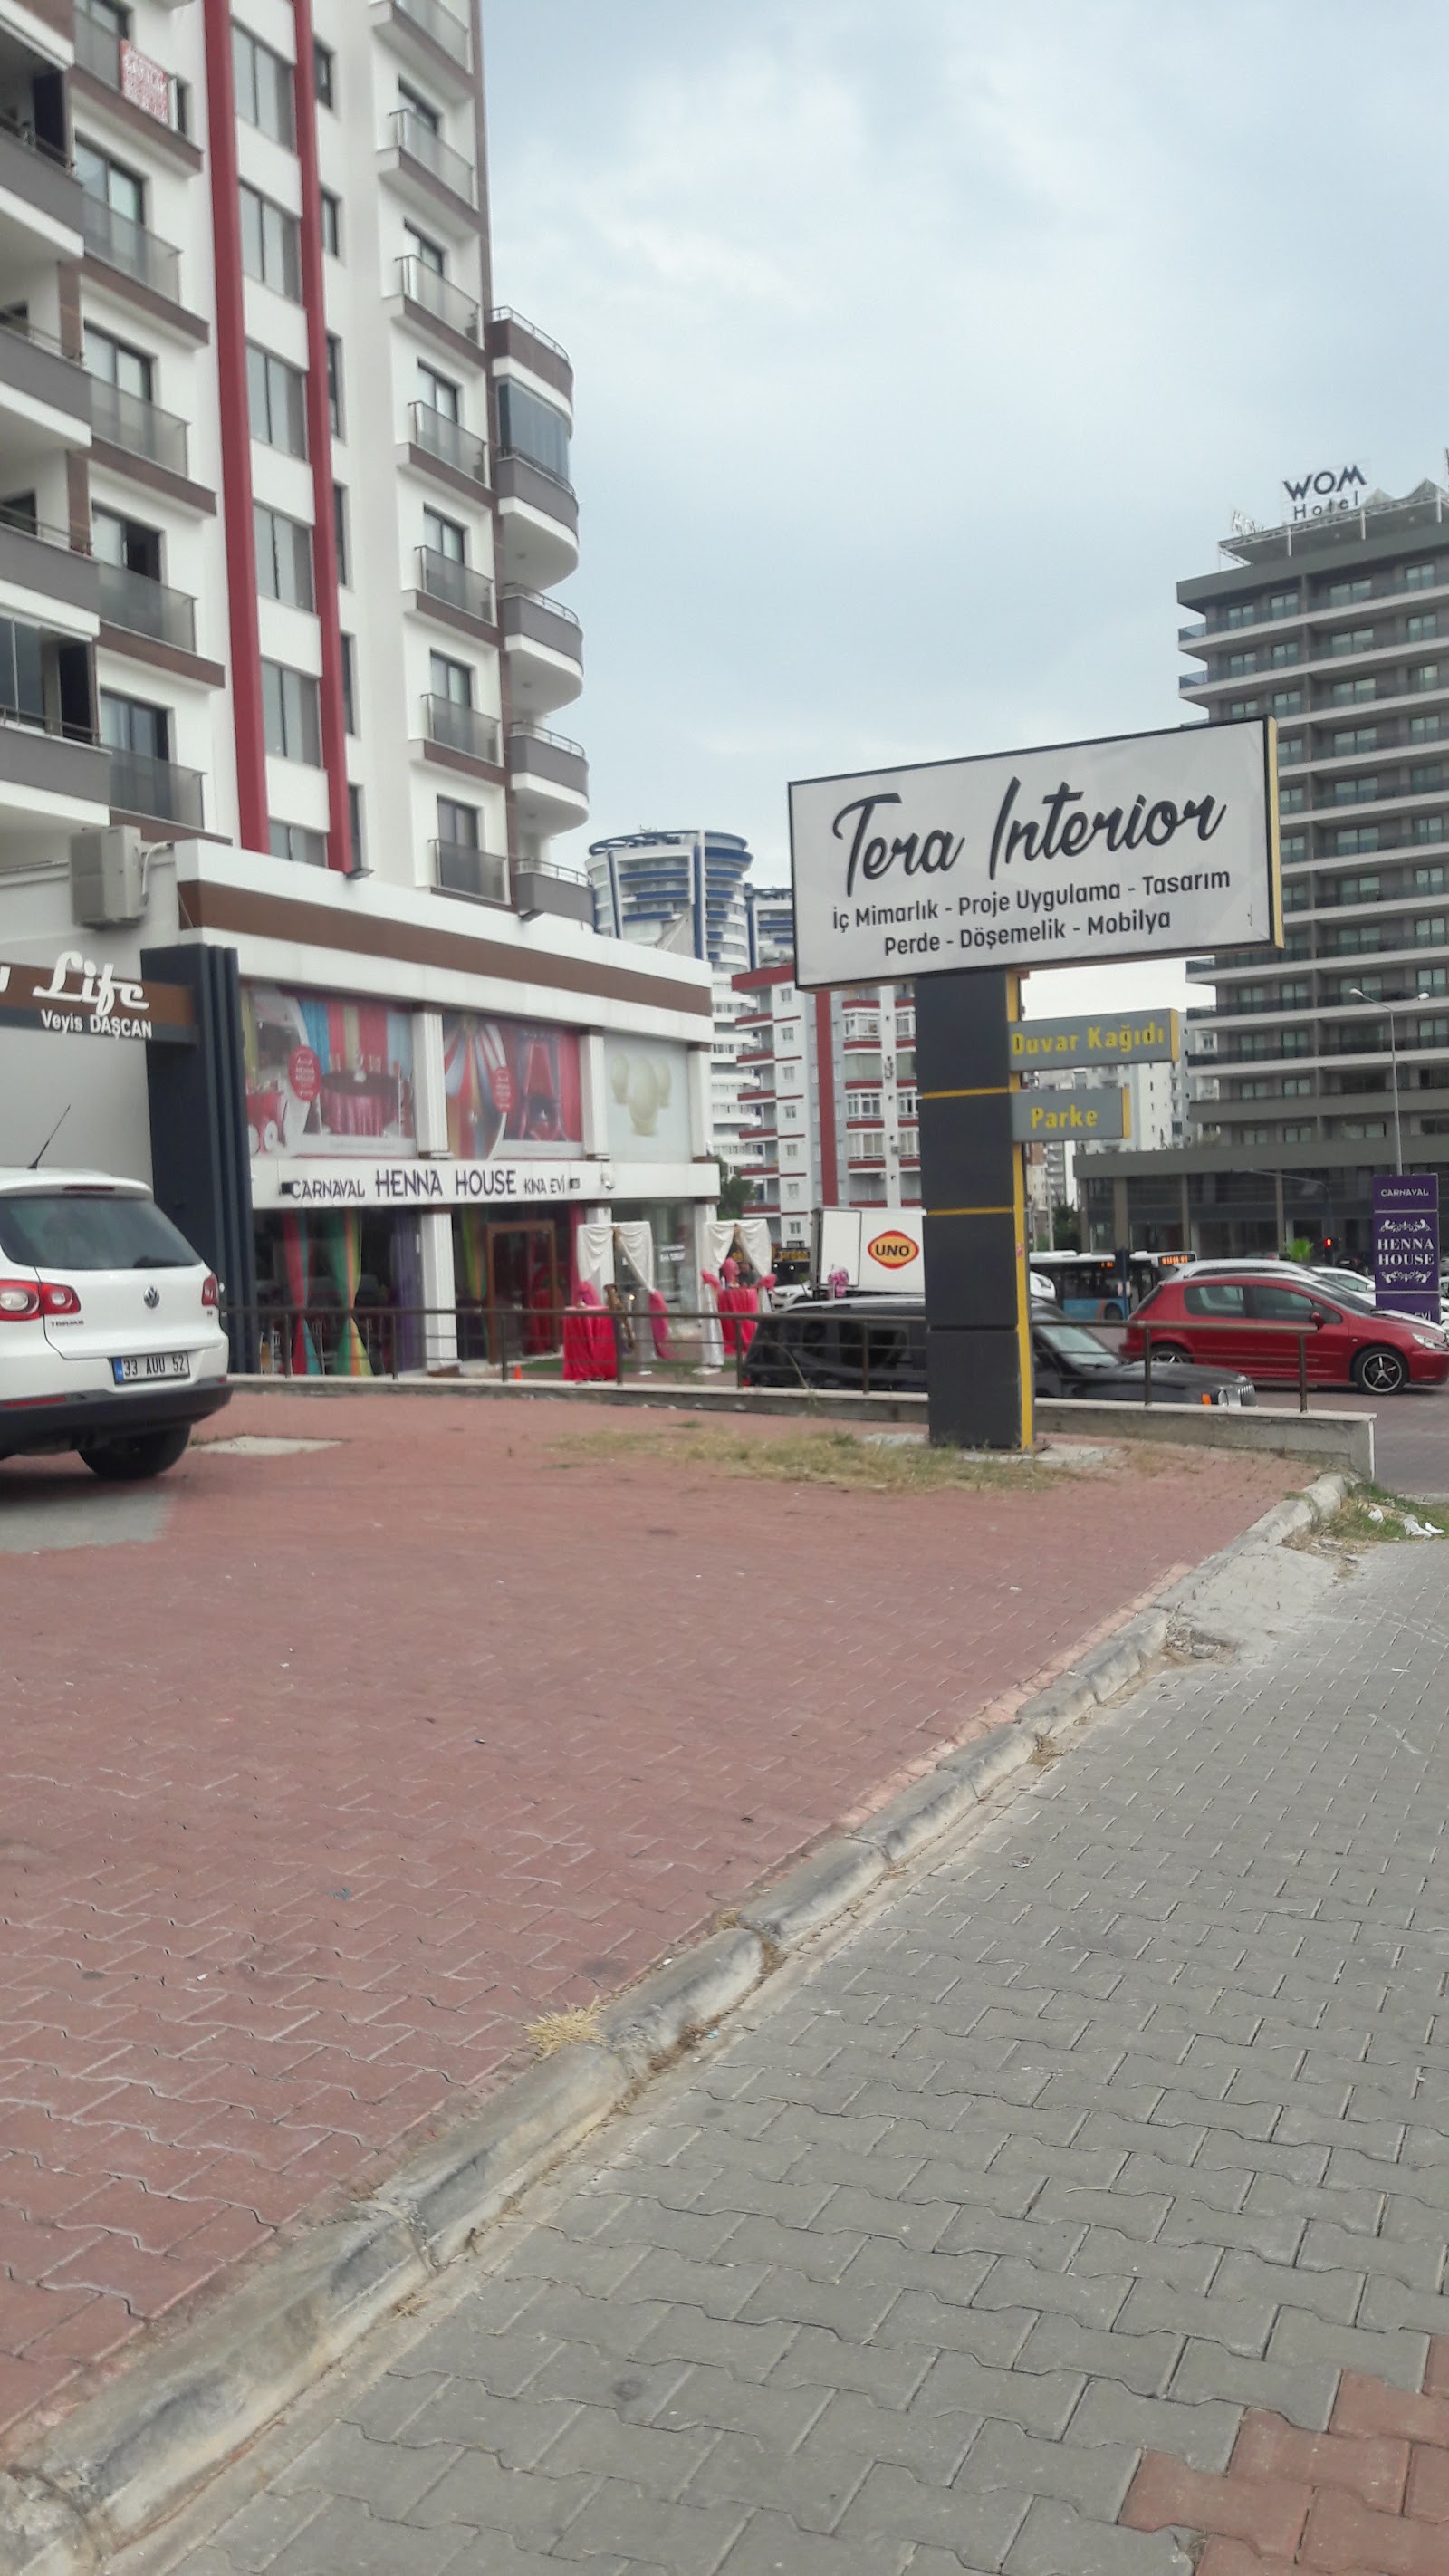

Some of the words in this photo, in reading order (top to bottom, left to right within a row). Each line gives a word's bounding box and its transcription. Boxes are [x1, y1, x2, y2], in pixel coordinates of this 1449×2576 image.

[1282, 465, 1367, 501] WOM
[1293, 490, 1360, 521] Hotel
[831, 793, 965, 898] Tera
[988, 776, 1226, 880] Interior
[855, 899, 939, 927] Mimarlık
[958, 891, 1010, 918] Proje
[1016, 882, 1121, 912] Uygulama
[1142, 870, 1231, 896] Tasarım
[884, 931, 941, 956] Perde
[960, 918, 1067, 950] Döşemelik
[1087, 908, 1172, 936] Mobilya
[32, 950, 150, 1016] Life
[41, 1008, 83, 1033] Veyis
[90, 1013, 153, 1040] DAŞCAN
[1012, 1033, 1080, 1055] Duvar
[1088, 1020, 1165, 1053] Kağıdı
[1031, 1103, 1099, 1129] Parke
[292, 1178, 366, 1199] CARNAVAL
[376, 1168, 444, 1197] HENNA
[455, 1168, 518, 1196] HOUSE
[1380, 1187, 1429, 1197] CARNAVAL
[875, 1244, 910, 1257] UNO
[1377, 1237, 1435, 1251] HENNA
[1378, 1253, 1435, 1266] HOUSE
[123, 1360, 138, 1377] 33
[172, 1353, 186, 1372] 52
